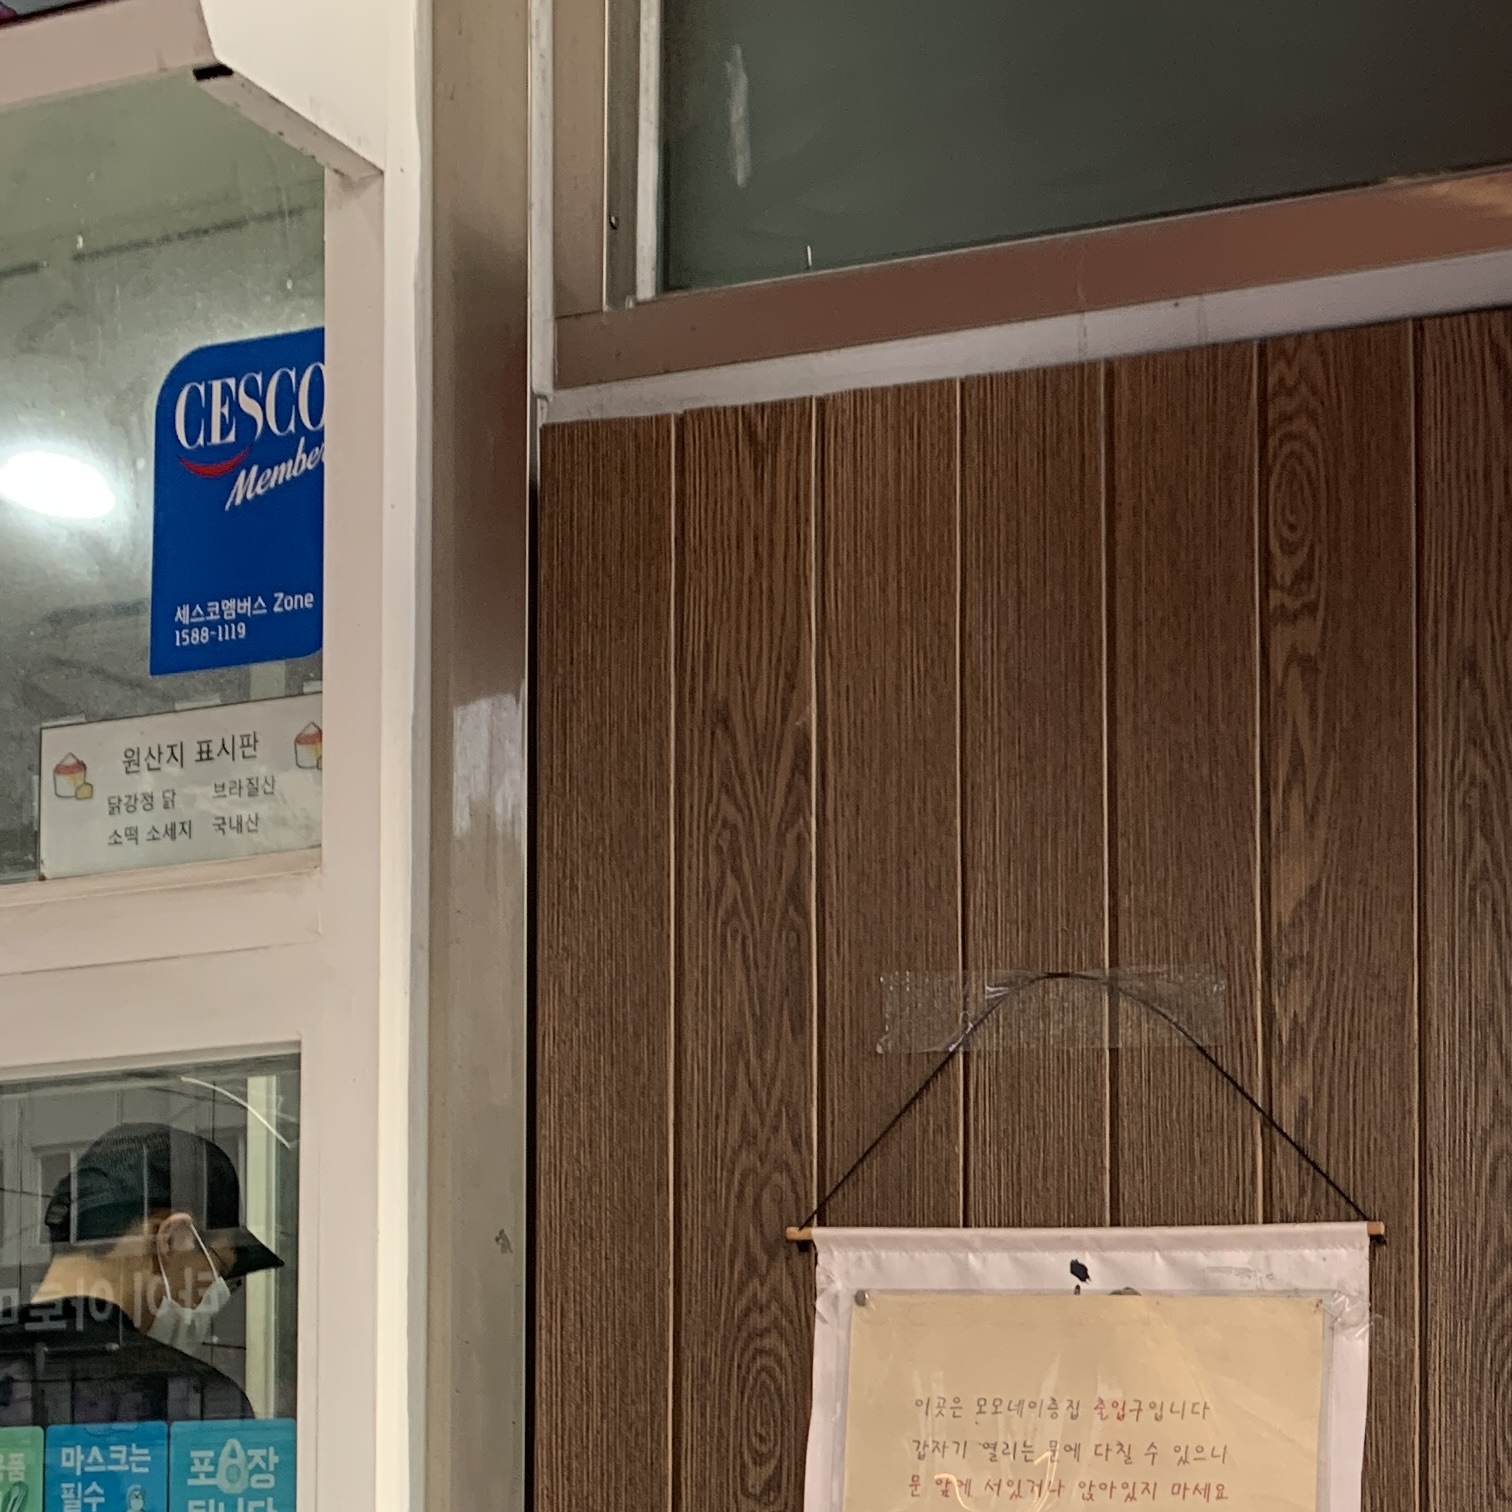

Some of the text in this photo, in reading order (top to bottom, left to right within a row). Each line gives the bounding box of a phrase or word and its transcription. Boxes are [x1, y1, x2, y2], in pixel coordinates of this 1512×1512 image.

[175, 362, 325, 449] CESCO
[274, 592, 314, 613] Zone
[175, 622, 246, 646] 1588-1119
[122, 731, 259, 774] 원산지 표시판
[107, 775, 276, 816] 닭강정 닭 브라질산
[107, 813, 260, 847] 소떡 소세지 국내산
[915, 1396, 1210, 1422] 이곳은 모모네이층집 출입구입니다
[61, 1444, 151, 1476] 마스크는
[187, 1446, 279, 1488] 포장
[912, 1439, 1227, 1466] 갑자기 열리는 문에 다칠 수 있으니
[908, 1474, 1228, 1502] 문 앞에 서있거나 앉아있지 마세요
